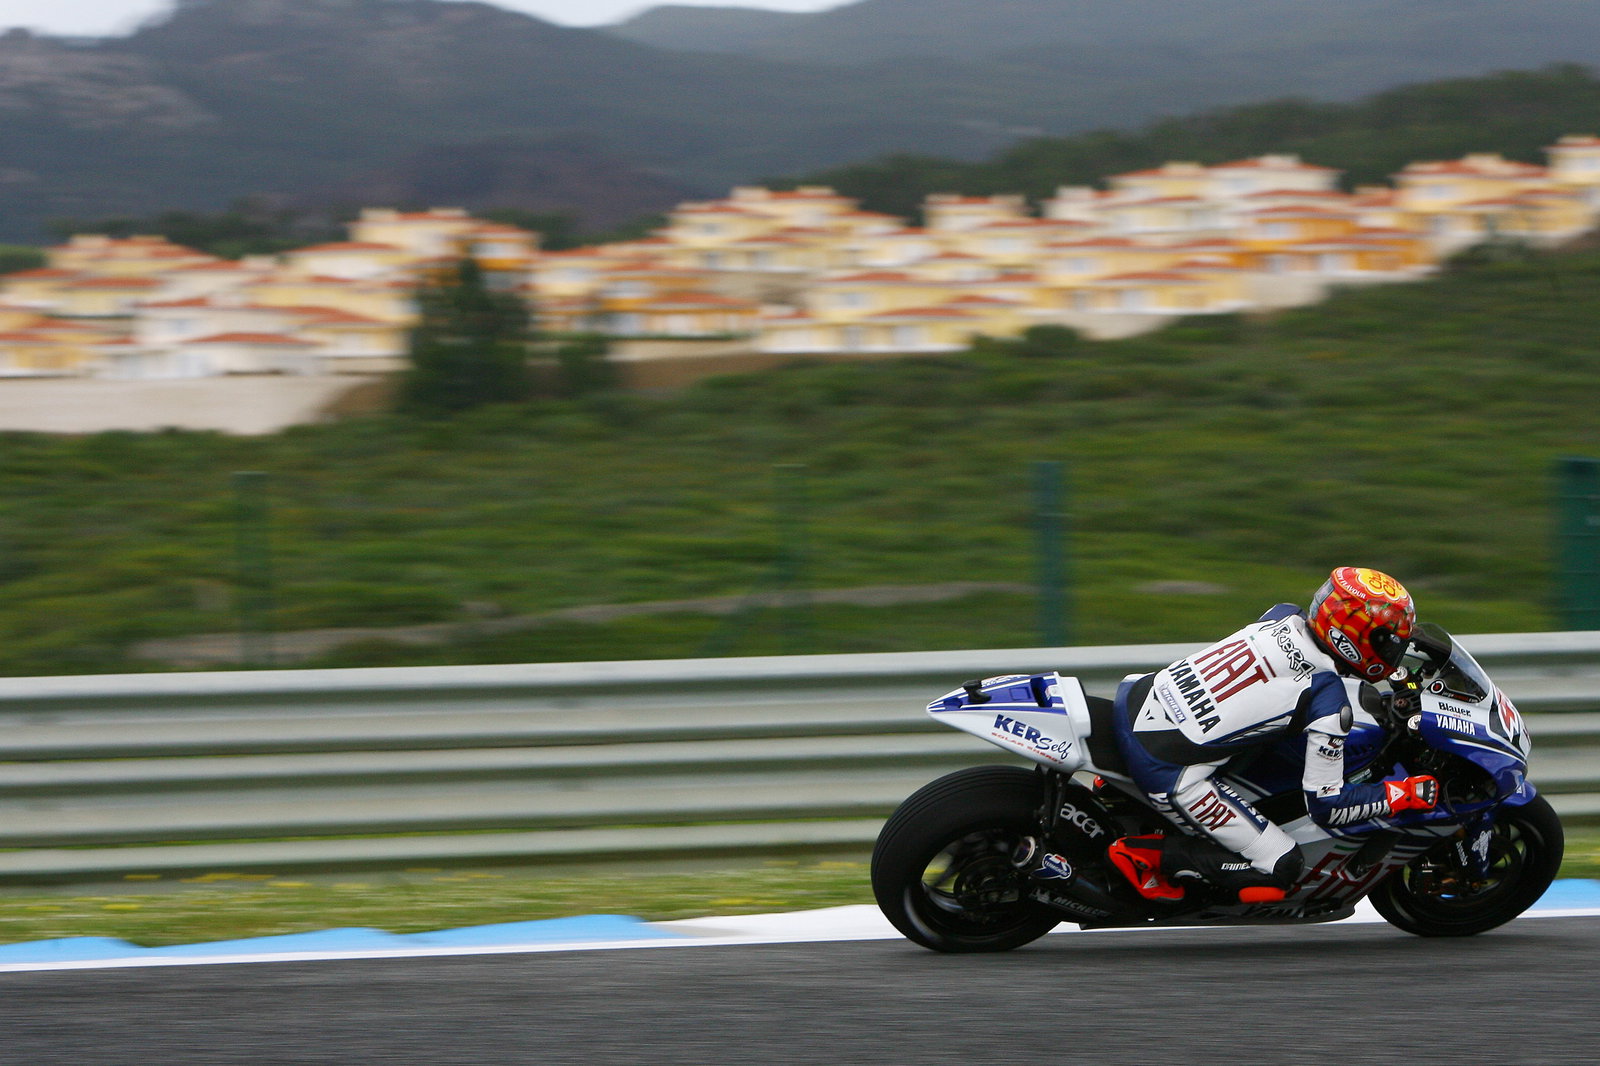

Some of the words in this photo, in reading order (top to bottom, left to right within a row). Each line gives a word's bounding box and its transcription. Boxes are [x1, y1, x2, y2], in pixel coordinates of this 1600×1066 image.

[1193, 638, 1269, 704] FIAT
[1160, 687, 1187, 724] MICHELIN
[1168, 658, 1222, 735] YAMAHA
[1438, 701, 1472, 718] Blauer
[1435, 714, 1476, 736] YAMAHA
[1060, 802, 1105, 838] acer
[1188, 789, 1237, 832] FIAT
[1328, 799, 1391, 825] YAMAHA
